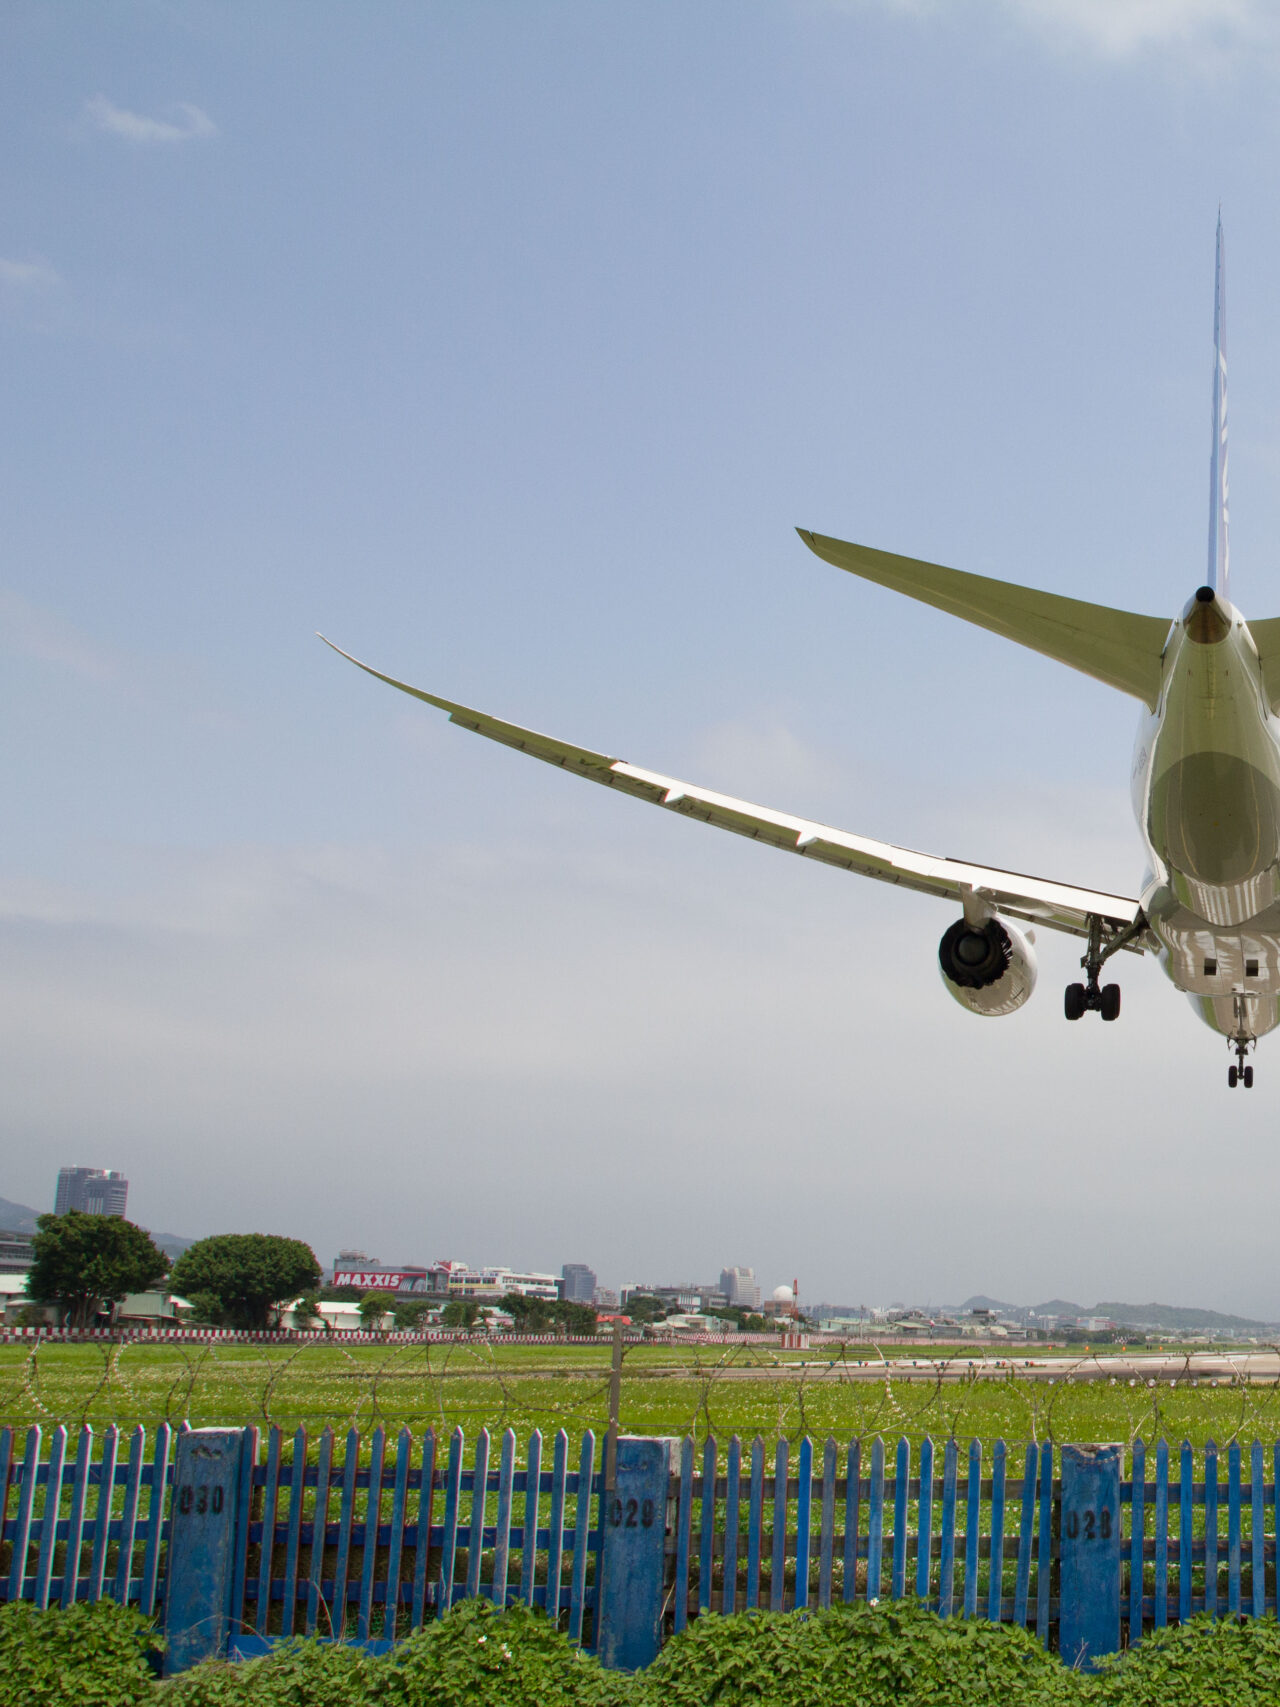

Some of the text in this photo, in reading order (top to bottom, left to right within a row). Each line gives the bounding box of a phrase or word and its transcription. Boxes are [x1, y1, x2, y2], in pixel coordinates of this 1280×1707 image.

[336, 1274, 400, 1287] MAXXIS
[609, 1499, 654, 1528] 029
[1067, 1510, 1112, 1540] 028
